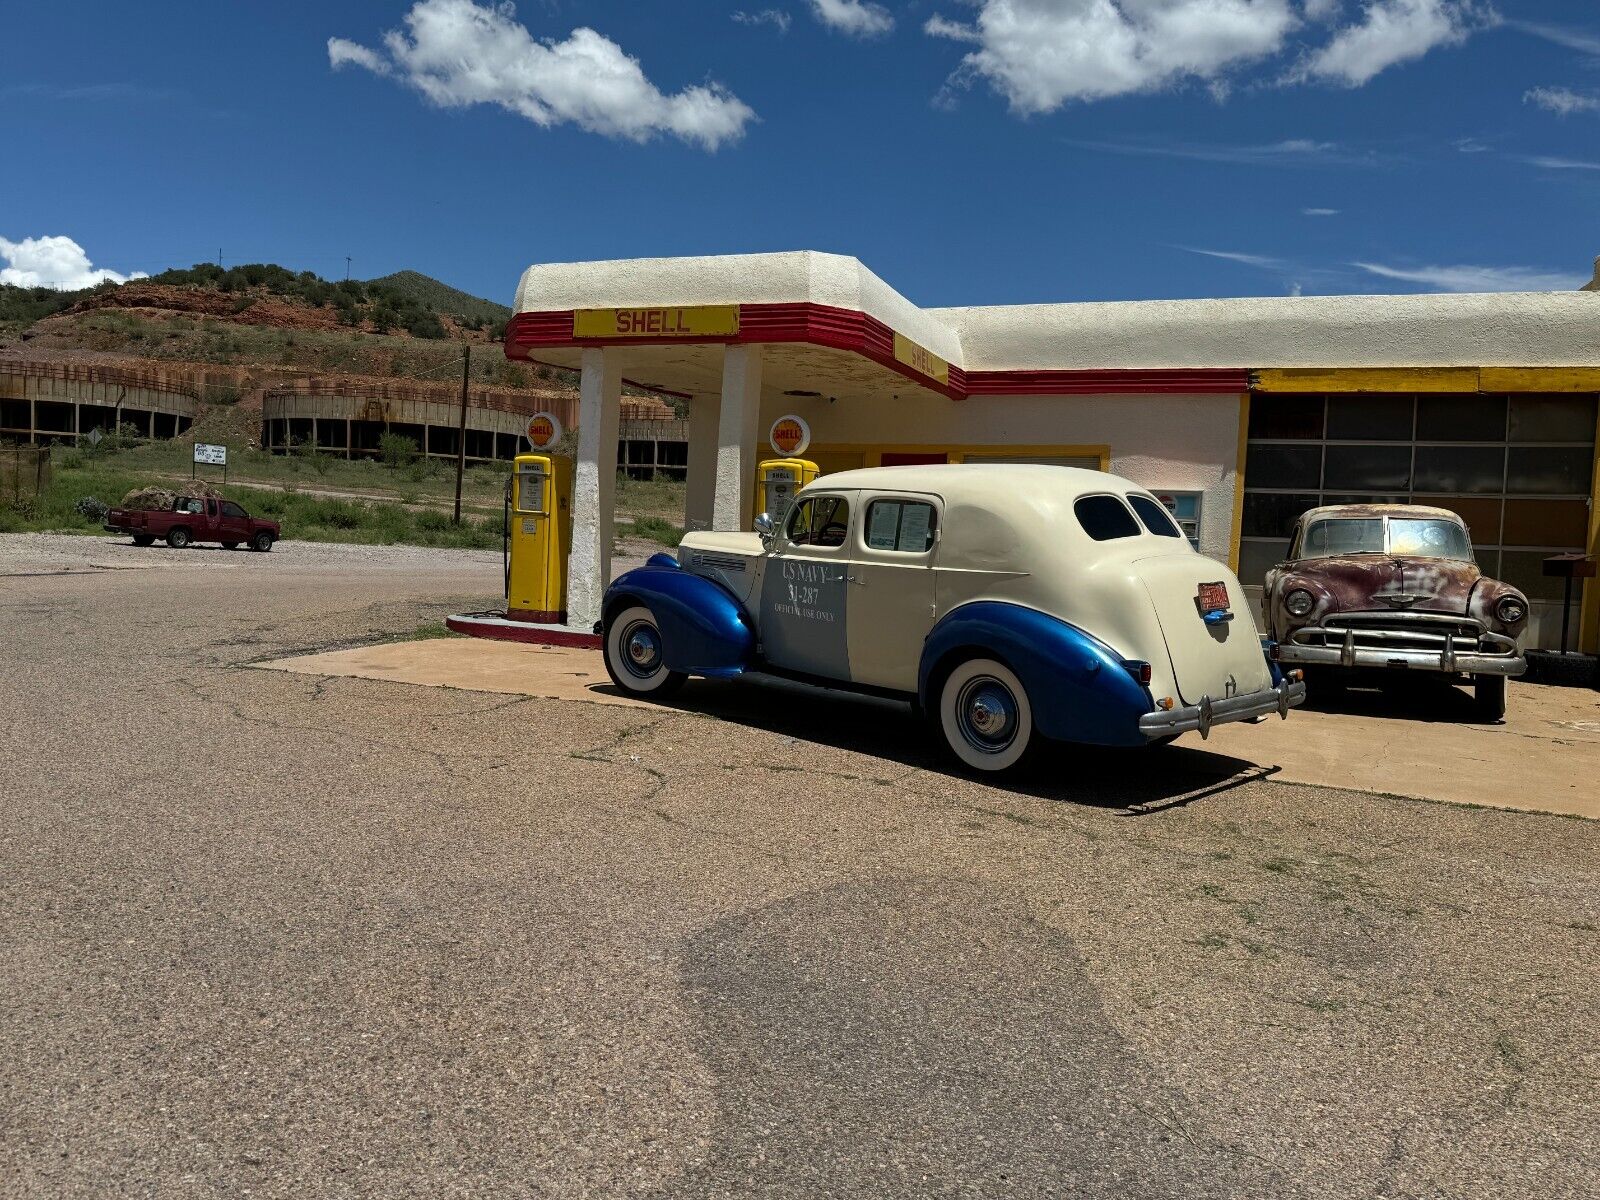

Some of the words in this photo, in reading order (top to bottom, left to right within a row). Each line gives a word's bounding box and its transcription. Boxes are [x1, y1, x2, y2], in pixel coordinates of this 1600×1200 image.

[616, 310, 691, 333] SHELL
[911, 344, 935, 376] SHELL
[530, 425, 551, 435] SHELL
[775, 429, 801, 439] SHELL
[782, 562, 795, 580] US
[797, 563, 829, 583] NAVY
[788, 584, 819, 604] 31-287
[802, 607, 815, 619] USE
[816, 610, 834, 622] ONLY
